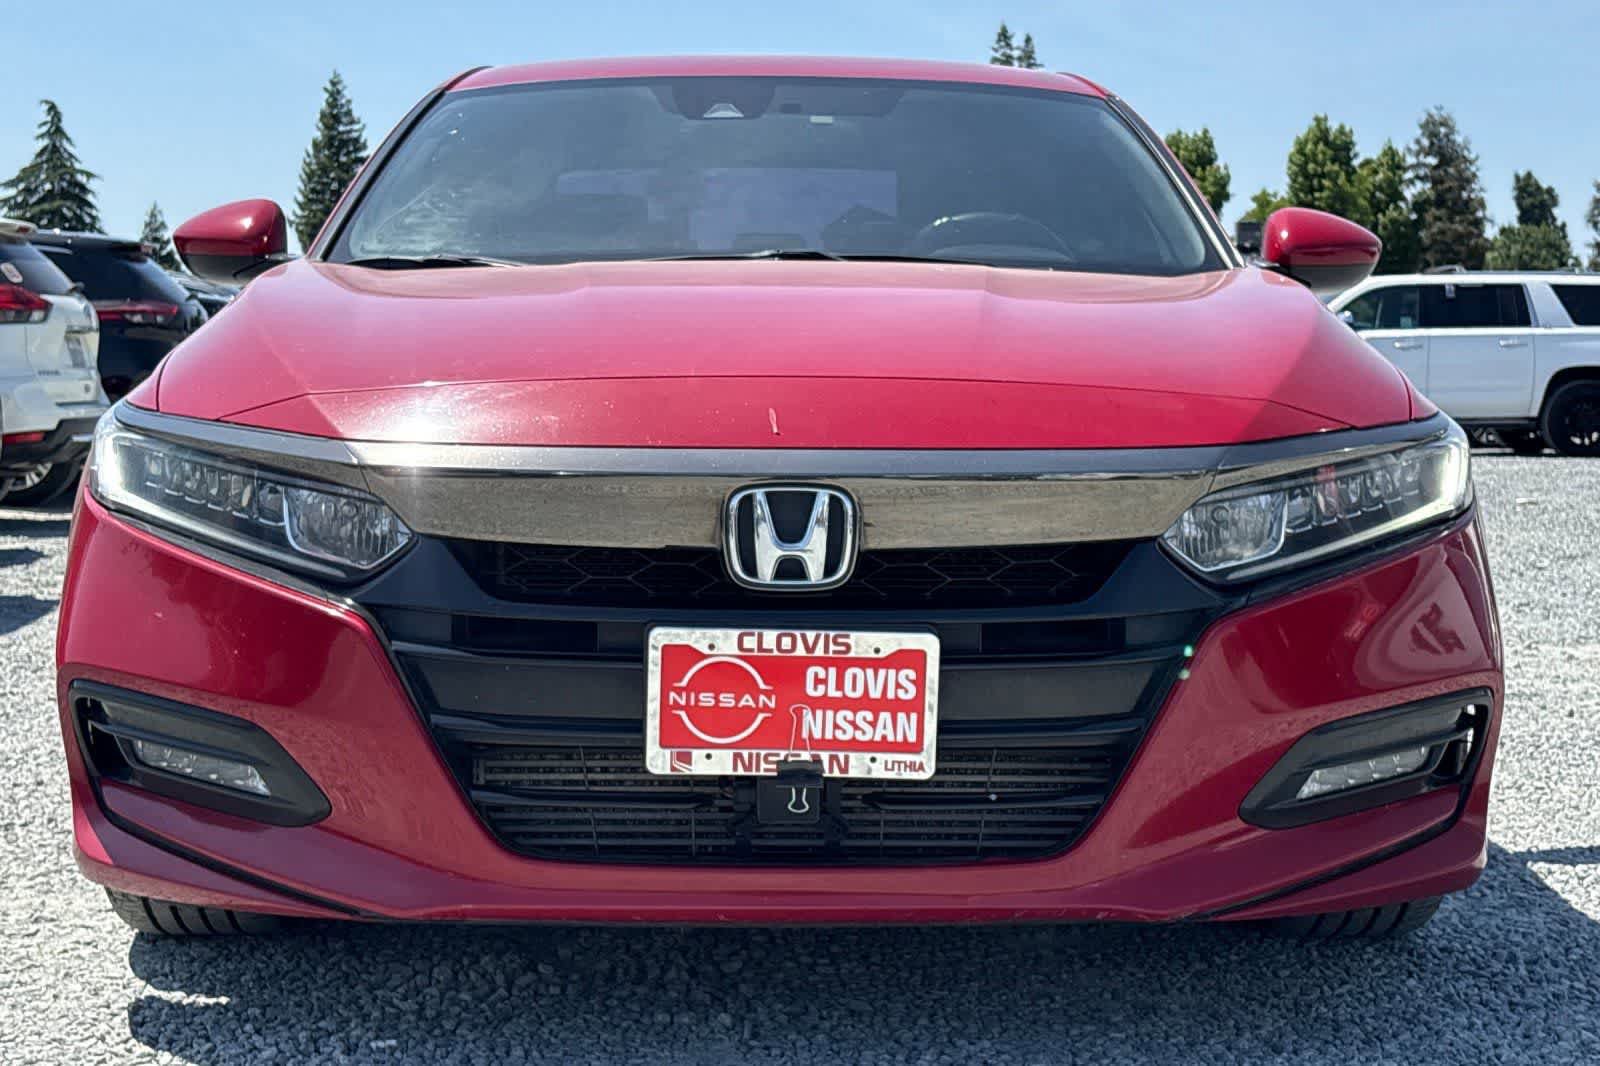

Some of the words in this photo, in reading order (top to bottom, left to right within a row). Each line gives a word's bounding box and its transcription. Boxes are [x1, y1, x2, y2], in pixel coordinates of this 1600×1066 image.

[737, 632, 852, 655] CLOVIS
[805, 666, 917, 700] CLOVIS
[668, 691, 776, 709] NISSAN
[801, 709, 917, 743] NISSAN
[884, 759, 925, 773] LITHIA
